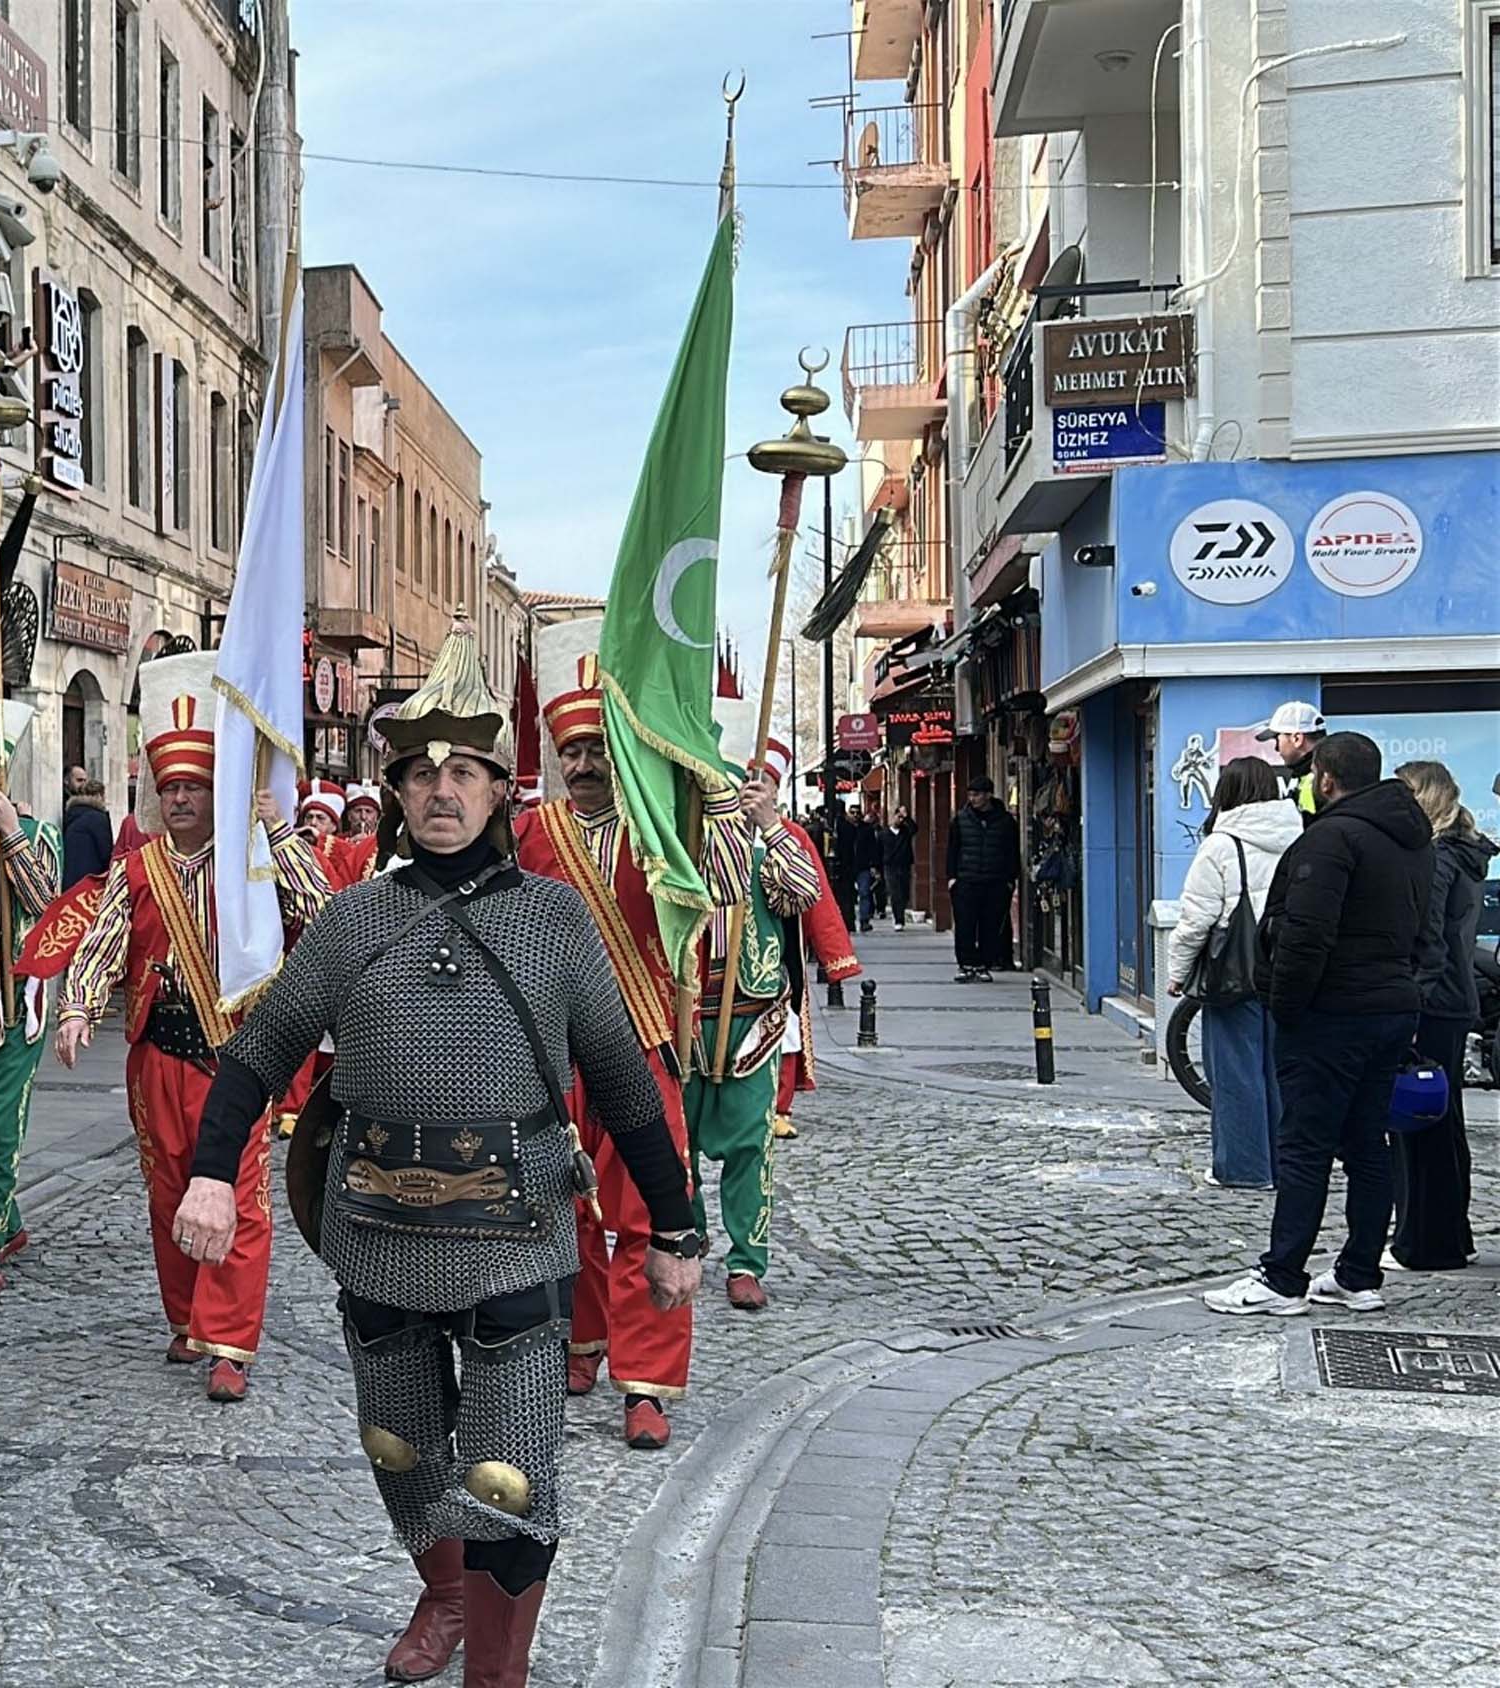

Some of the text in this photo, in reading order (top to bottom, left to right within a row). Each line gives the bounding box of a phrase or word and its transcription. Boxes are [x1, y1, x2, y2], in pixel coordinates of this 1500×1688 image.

[1068, 326, 1169, 359] AVUKAT
[1053, 366, 1187, 392] MEHMET ALTIN
[1056, 411, 1128, 430] SÜREYYA
[1057, 430, 1109, 448] ÜZMEZ
[1056, 449, 1089, 459] SOKAK
[1313, 532, 1416, 547] APNEA
[1311, 546, 1418, 558] Hold Your Breath
[1187, 563, 1277, 580] DAIWA
